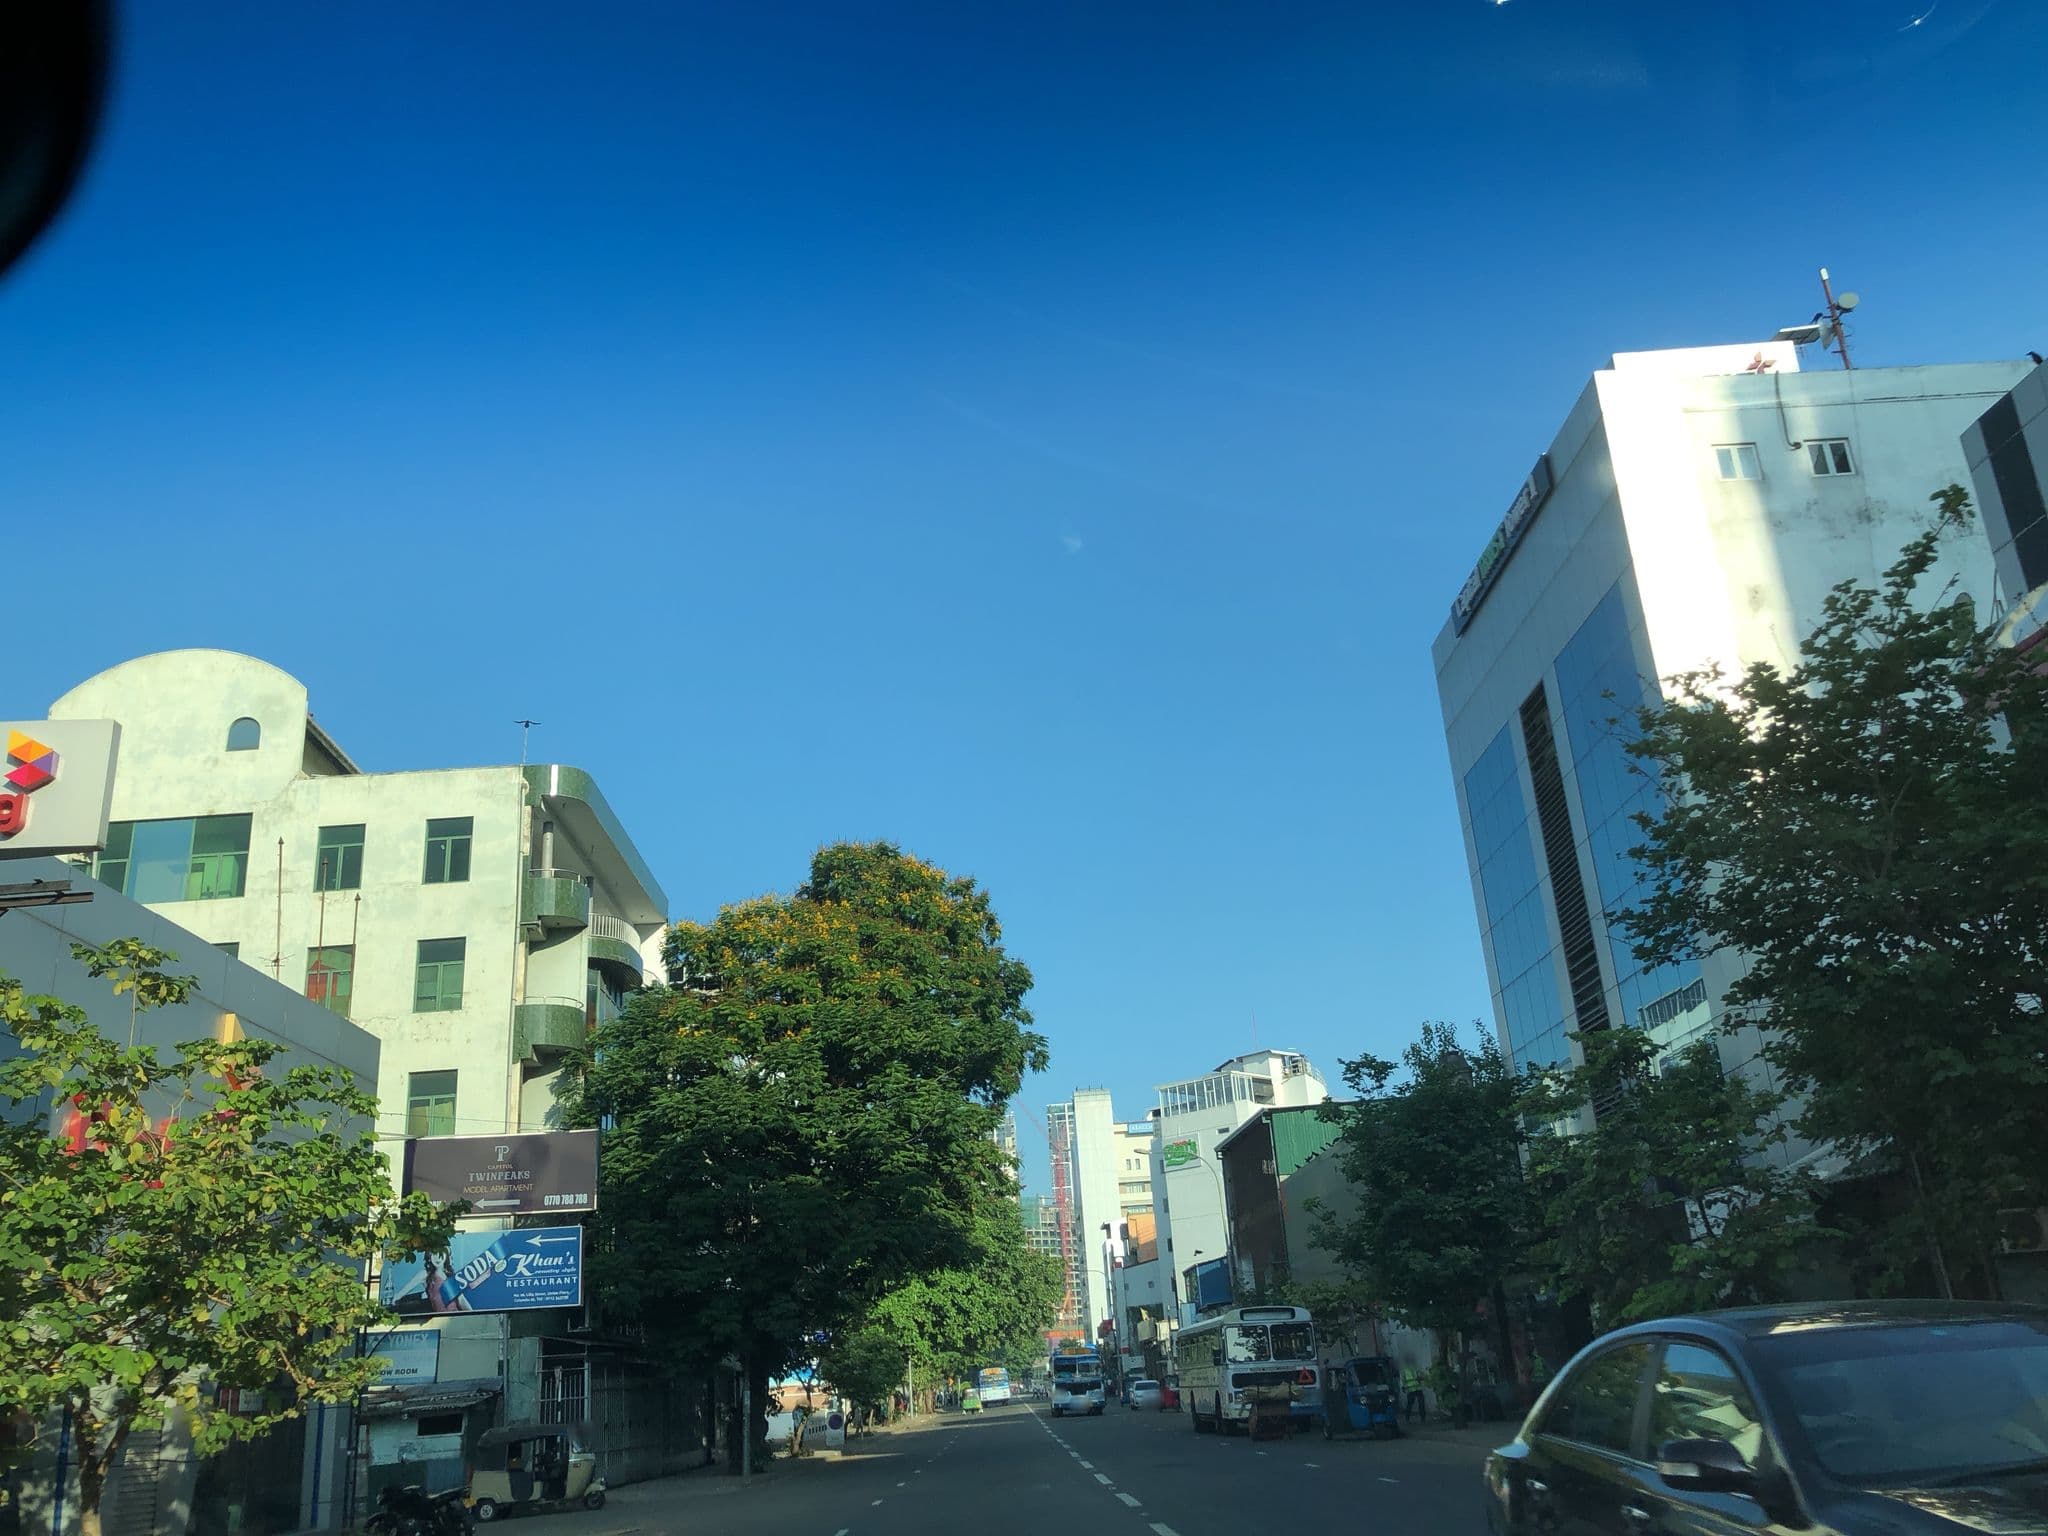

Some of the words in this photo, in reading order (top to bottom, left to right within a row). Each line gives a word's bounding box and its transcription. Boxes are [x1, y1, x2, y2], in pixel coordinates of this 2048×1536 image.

[469, 1170, 531, 1182] TWINPEAKS
[490, 1183, 535, 1193] APARTMENT
[454, 1250, 498, 1290] SODA
[504, 1251, 576, 1278] Khan's
[506, 1276, 577, 1288] RESTAURANT
